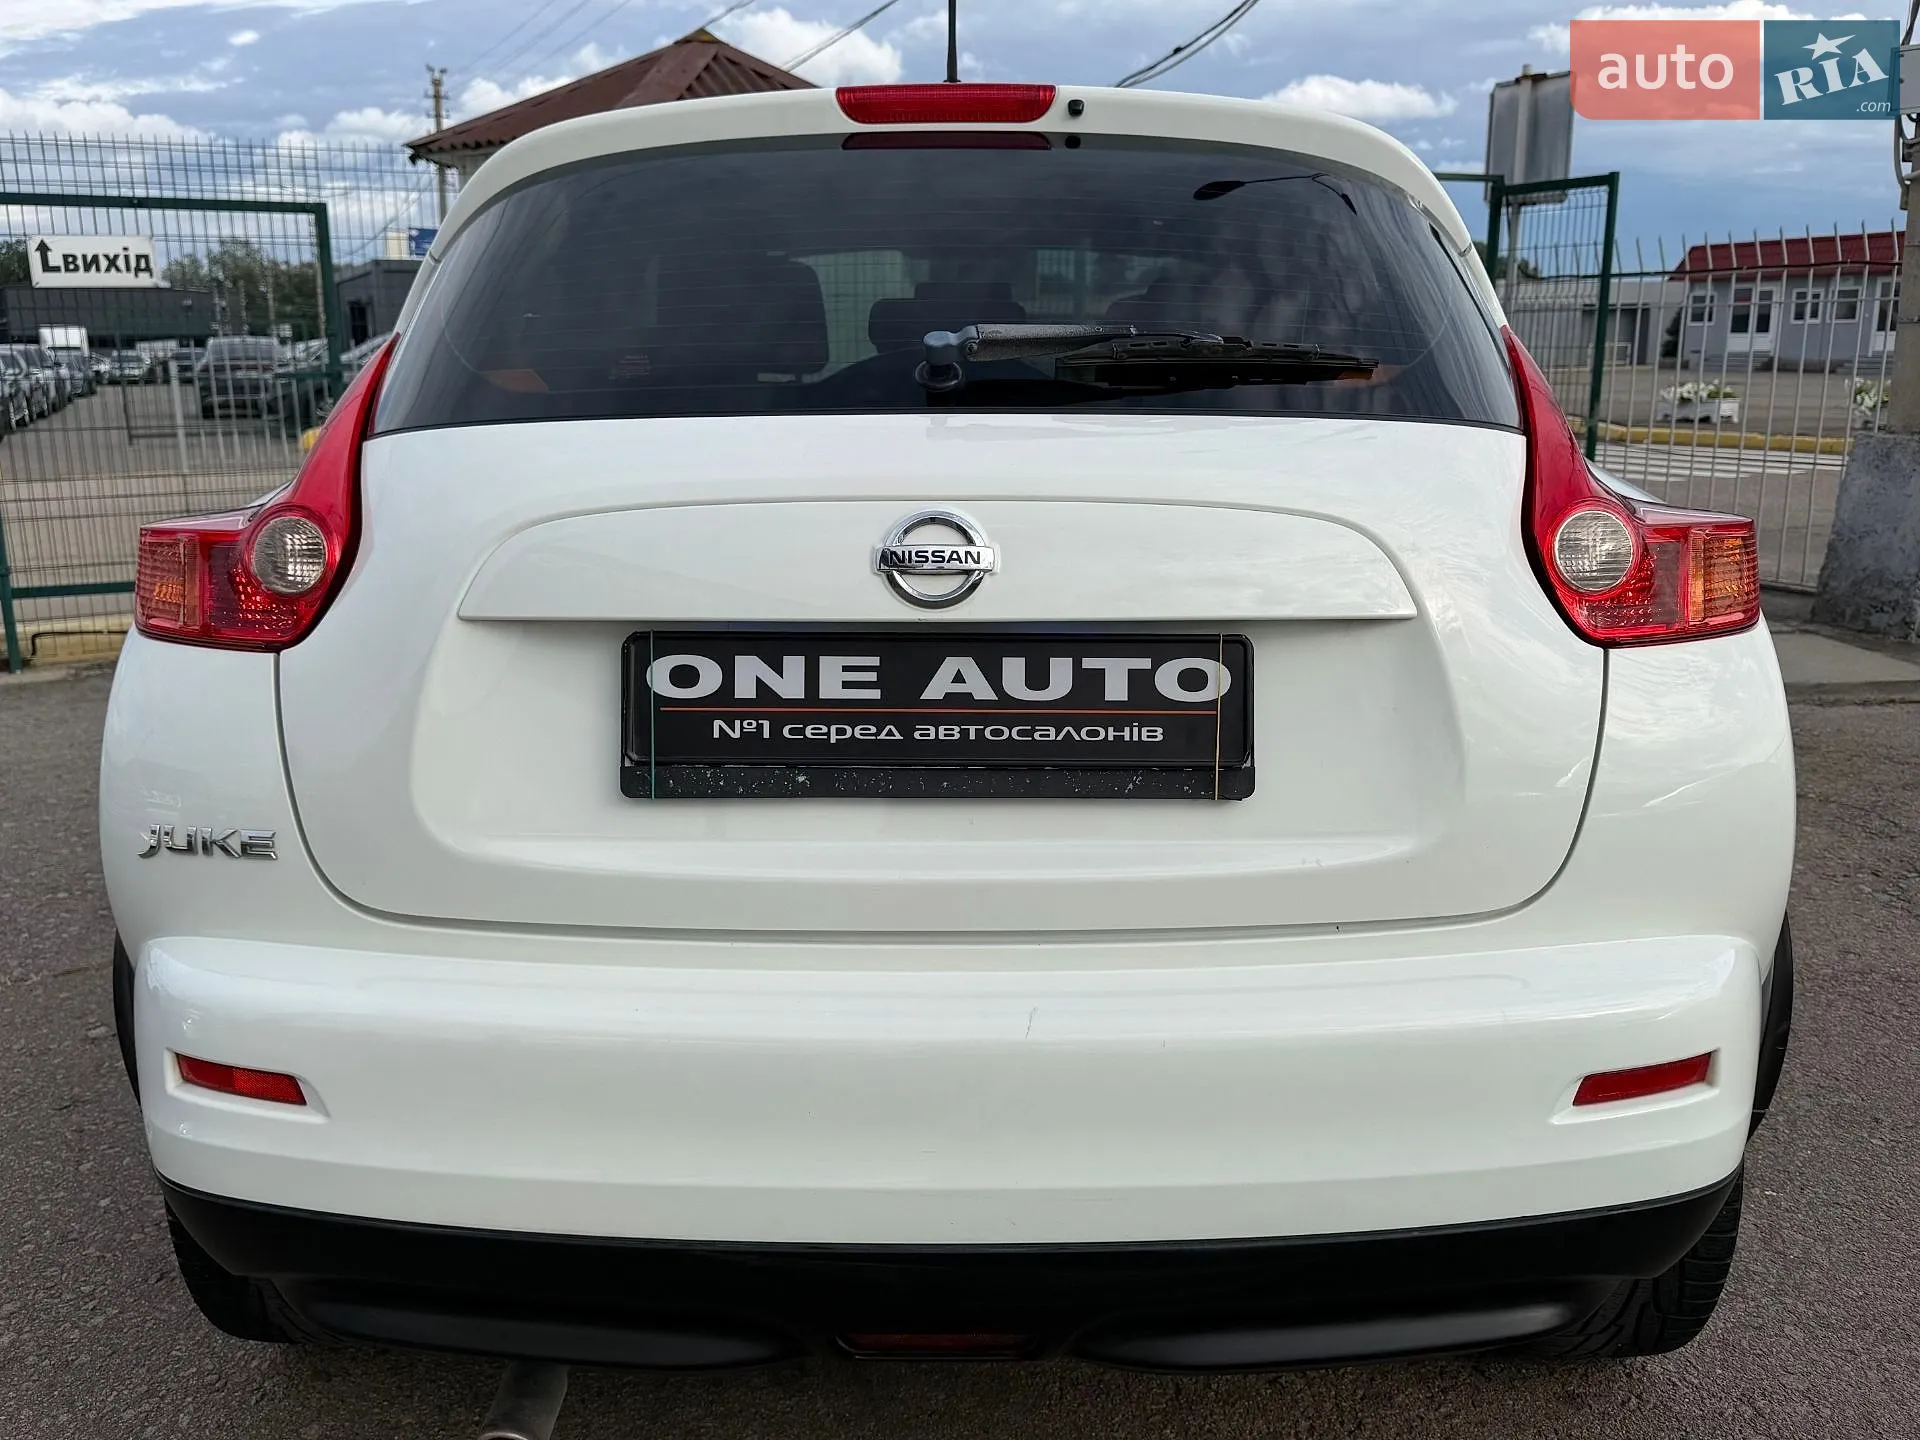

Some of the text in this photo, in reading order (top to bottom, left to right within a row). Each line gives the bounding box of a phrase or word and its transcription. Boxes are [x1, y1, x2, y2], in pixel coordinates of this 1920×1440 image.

[62, 247, 153, 278] вихід
[889, 549, 981, 565] NISSAN
[646, 654, 1232, 702] ONE AUTO
[782, 724, 904, 743] серед
[913, 722, 1164, 742] автосалонів
[137, 824, 278, 860] JUKE
